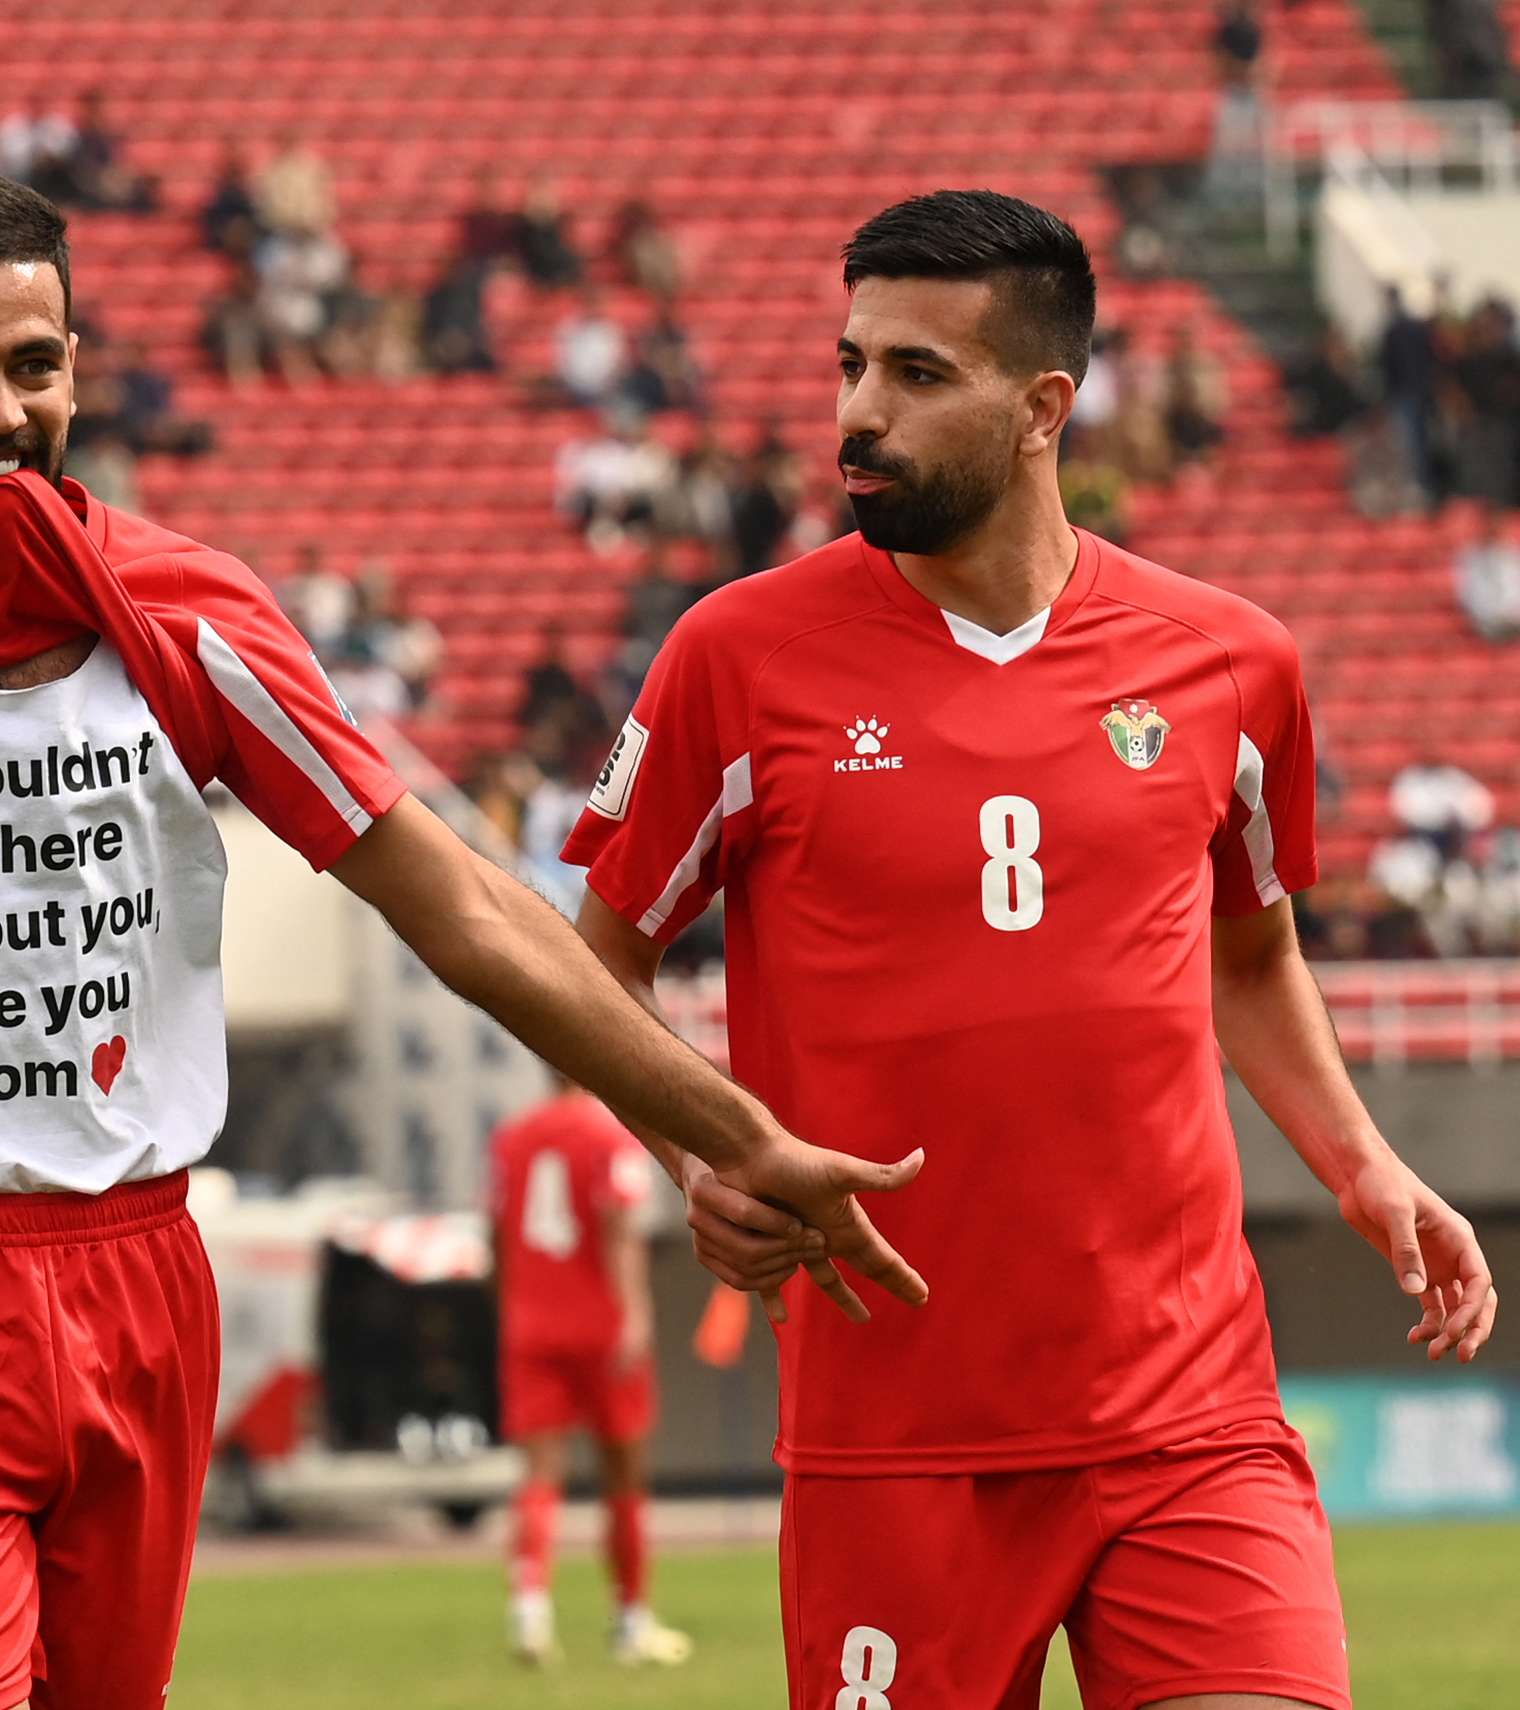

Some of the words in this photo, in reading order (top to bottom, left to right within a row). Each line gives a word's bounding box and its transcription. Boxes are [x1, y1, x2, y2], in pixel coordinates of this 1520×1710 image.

[833, 755, 904, 773] KELME
[0, 821, 123, 874] here
[979, 795, 1044, 932] 8
[80, 887, 161, 955] you,
[40, 971, 130, 1037] you
[836, 1626, 897, 1710] 8
